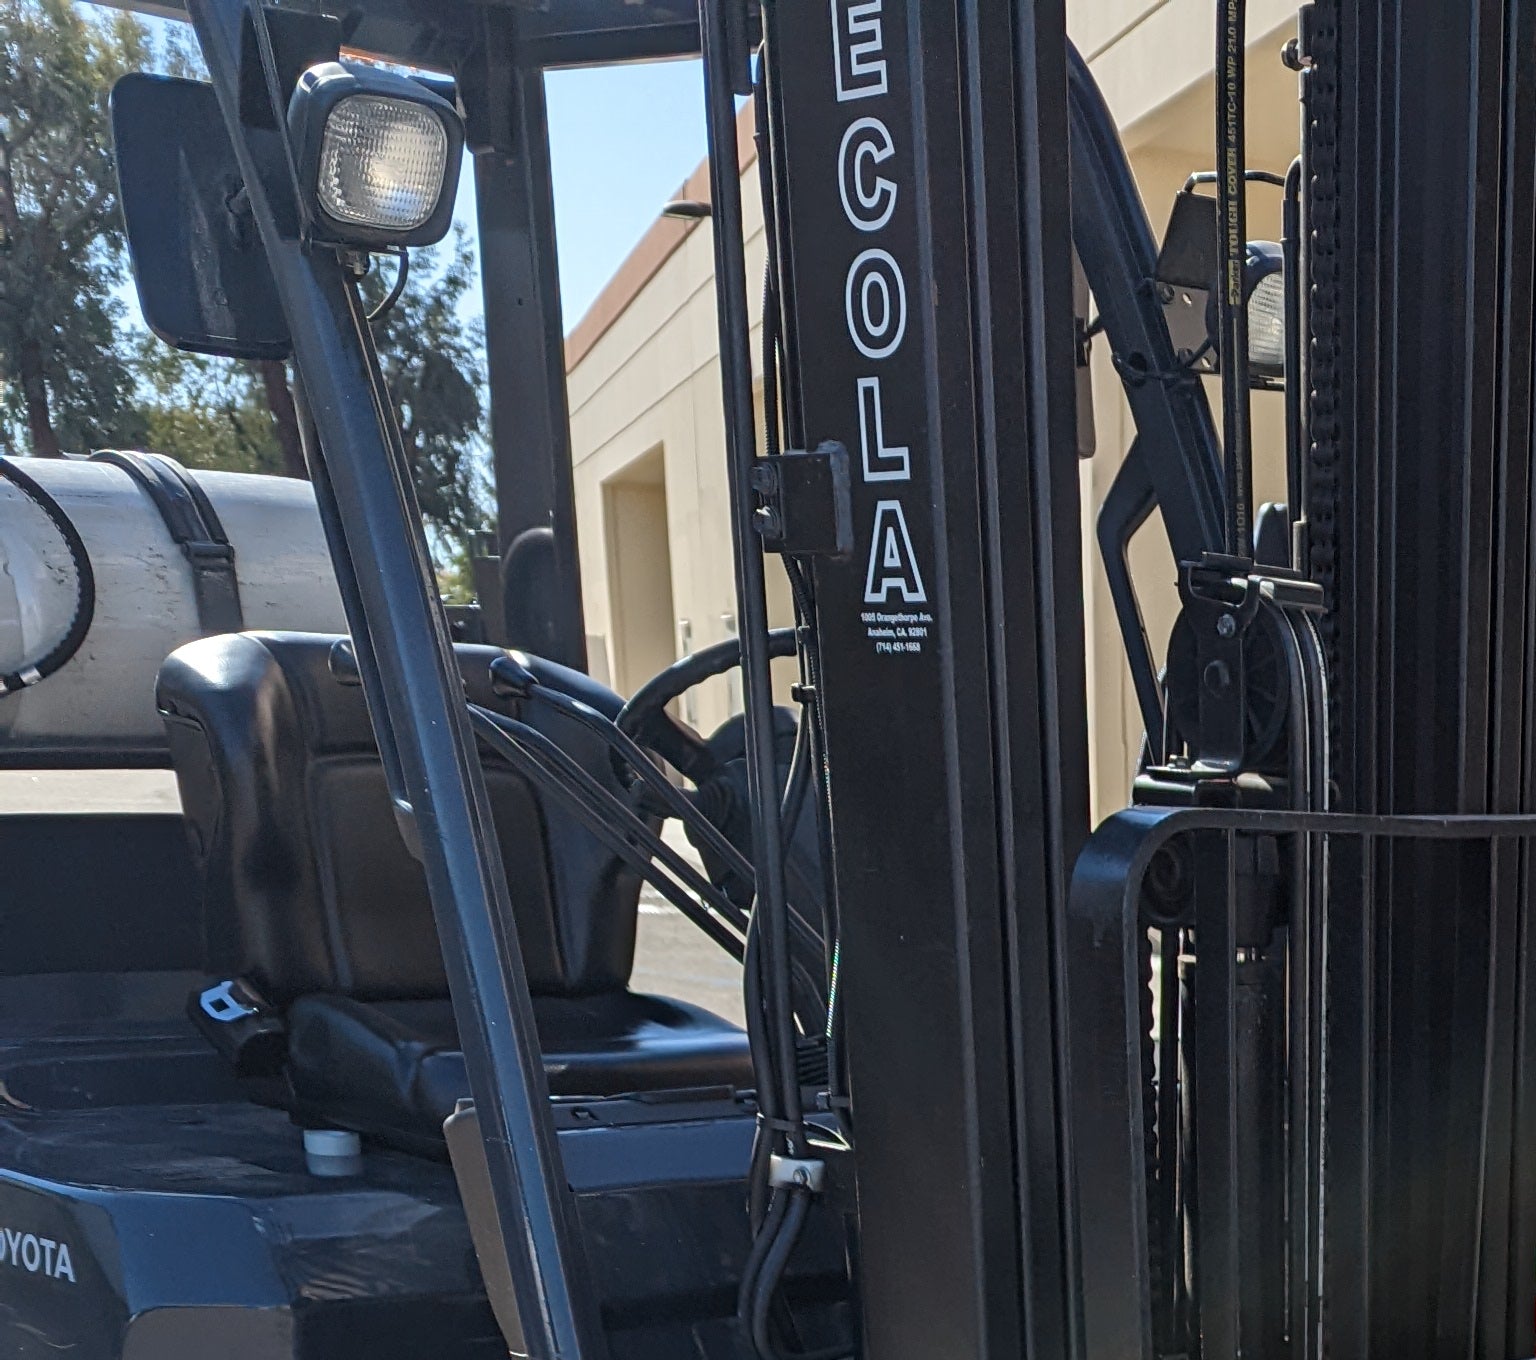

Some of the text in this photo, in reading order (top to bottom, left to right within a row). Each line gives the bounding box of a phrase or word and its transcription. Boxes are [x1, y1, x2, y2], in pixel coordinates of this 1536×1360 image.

[1228, 0, 1238, 22] MP
[1226, 56, 1237, 79] WP
[1227, 147, 1238, 196] COVER
[1228, 200, 1239, 257] TOUGH
[830, 0, 926, 603] ECOLA
